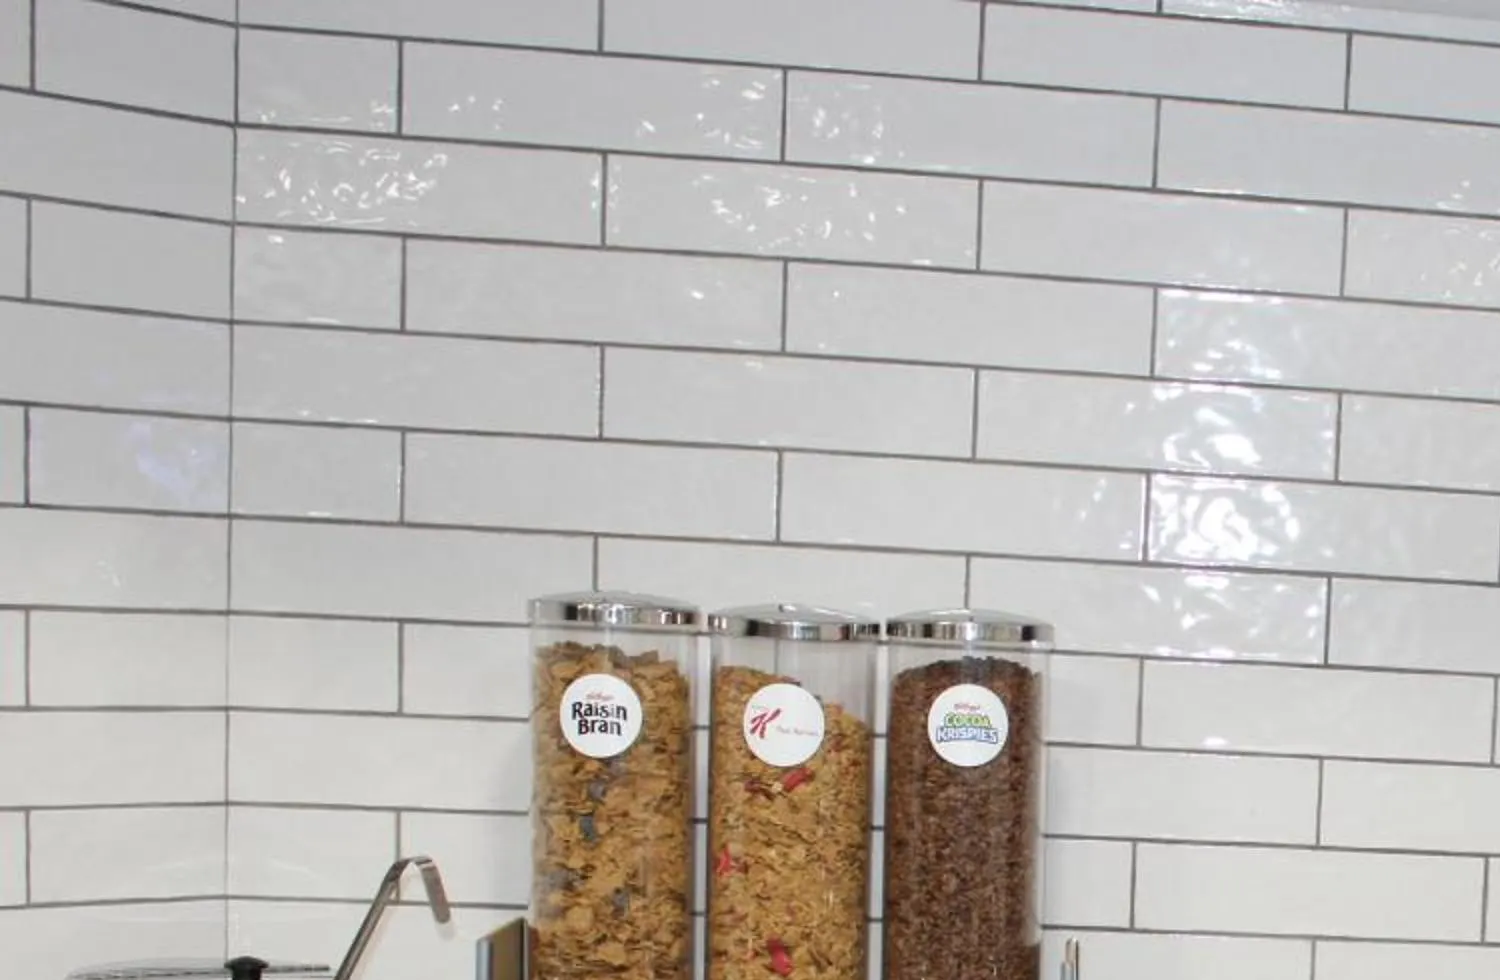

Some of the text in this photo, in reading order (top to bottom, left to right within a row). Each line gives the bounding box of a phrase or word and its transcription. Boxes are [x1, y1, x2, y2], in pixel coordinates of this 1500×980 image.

[571, 701, 628, 721] Raisin
[944, 712, 992, 728] COCOA
[577, 719, 622, 736] Bran
[749, 707, 782, 739] K
[936, 726, 999, 744] KRISPIES
